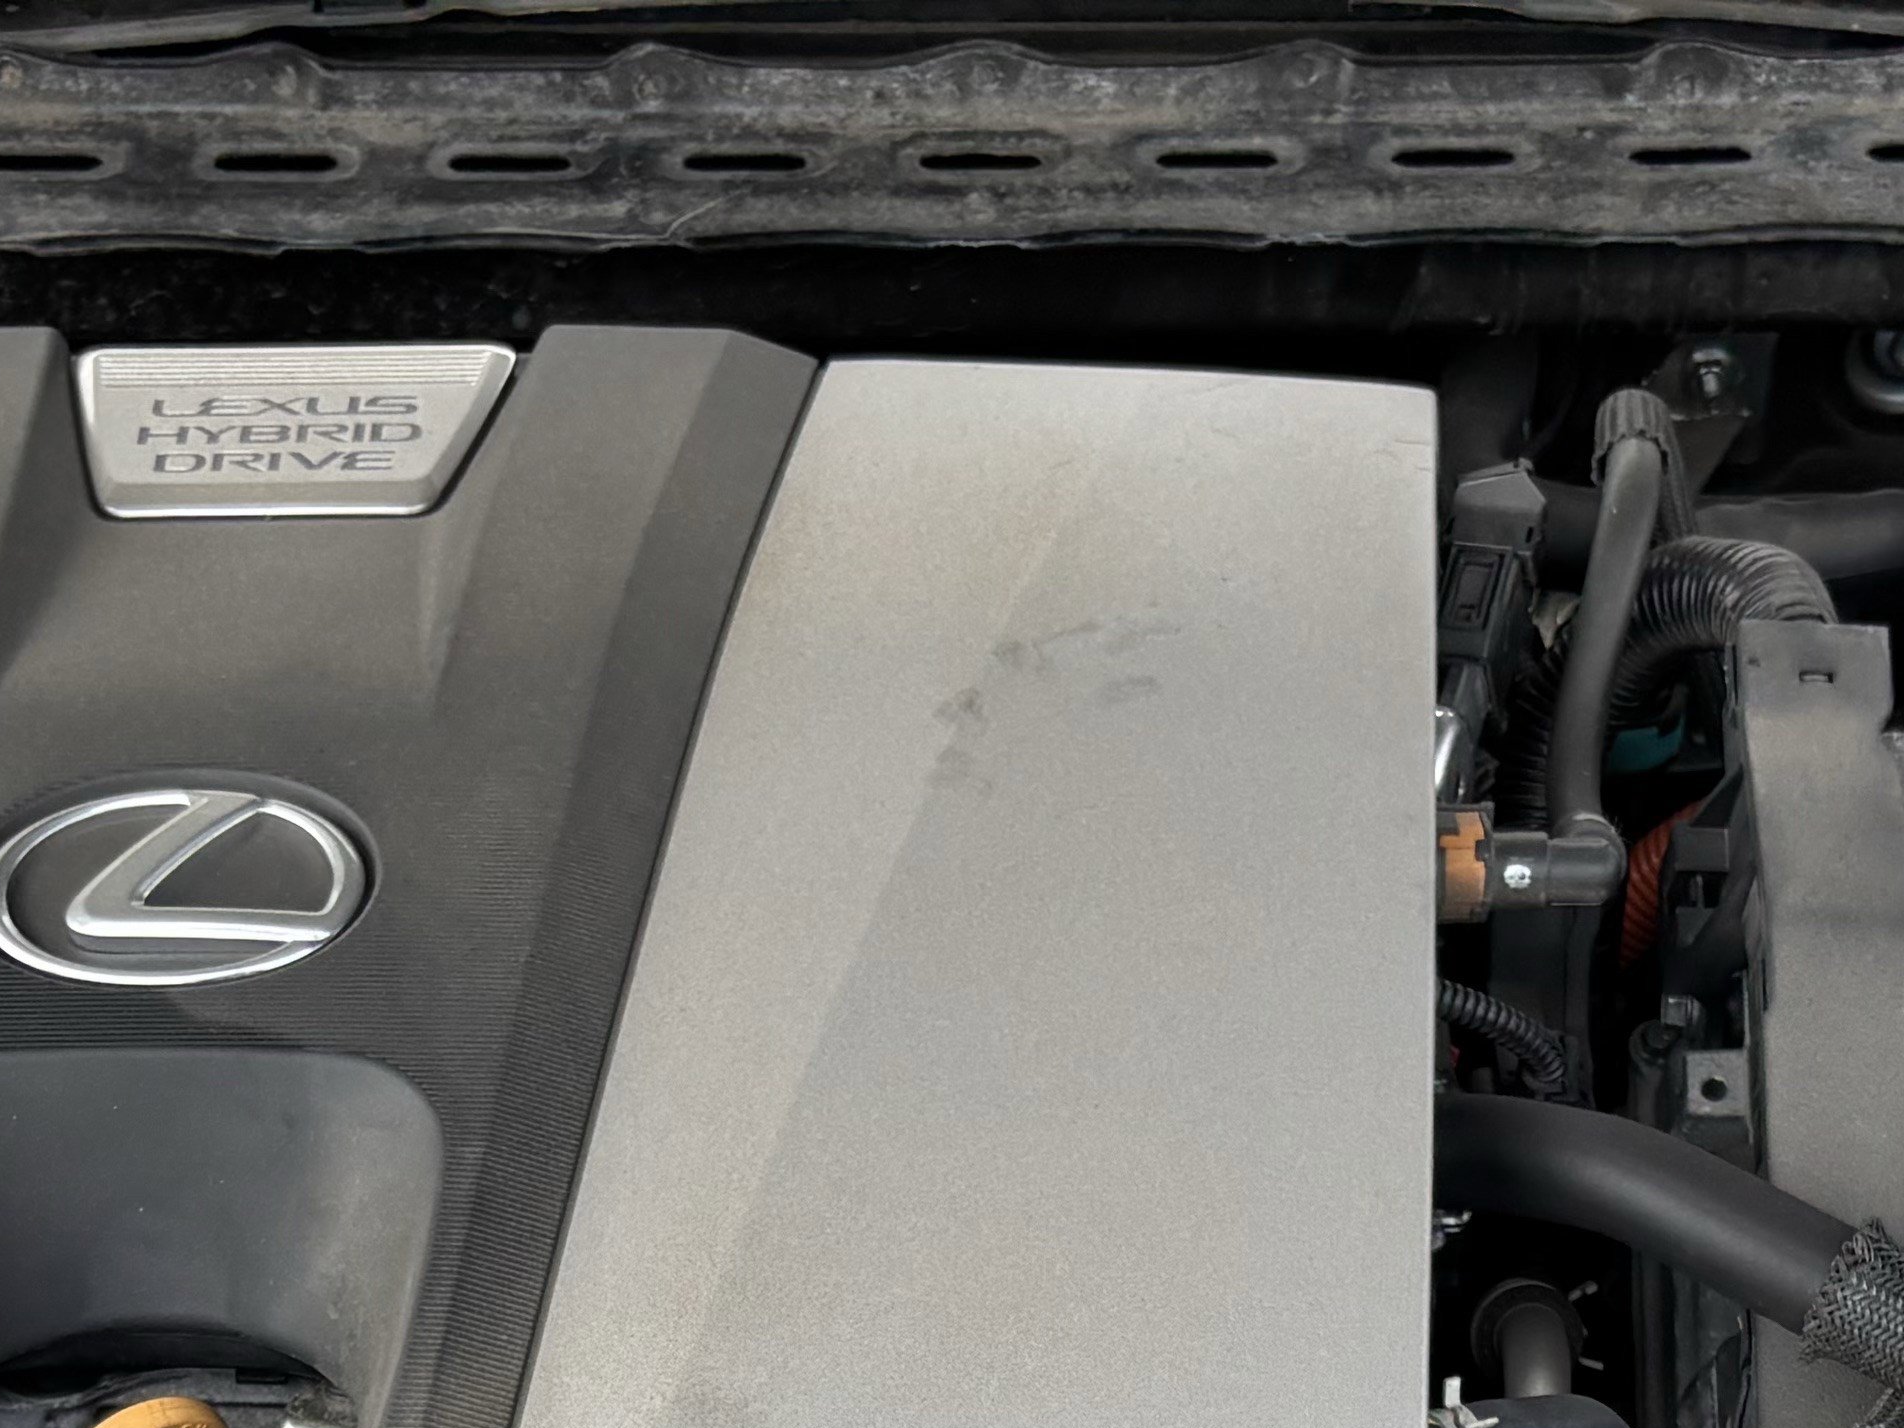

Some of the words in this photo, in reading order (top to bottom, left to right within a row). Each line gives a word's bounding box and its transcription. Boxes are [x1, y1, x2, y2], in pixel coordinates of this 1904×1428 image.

[151, 395, 418, 418] LEXUS
[136, 422, 422, 447] HYBRID
[152, 450, 396, 474] DRIVE
